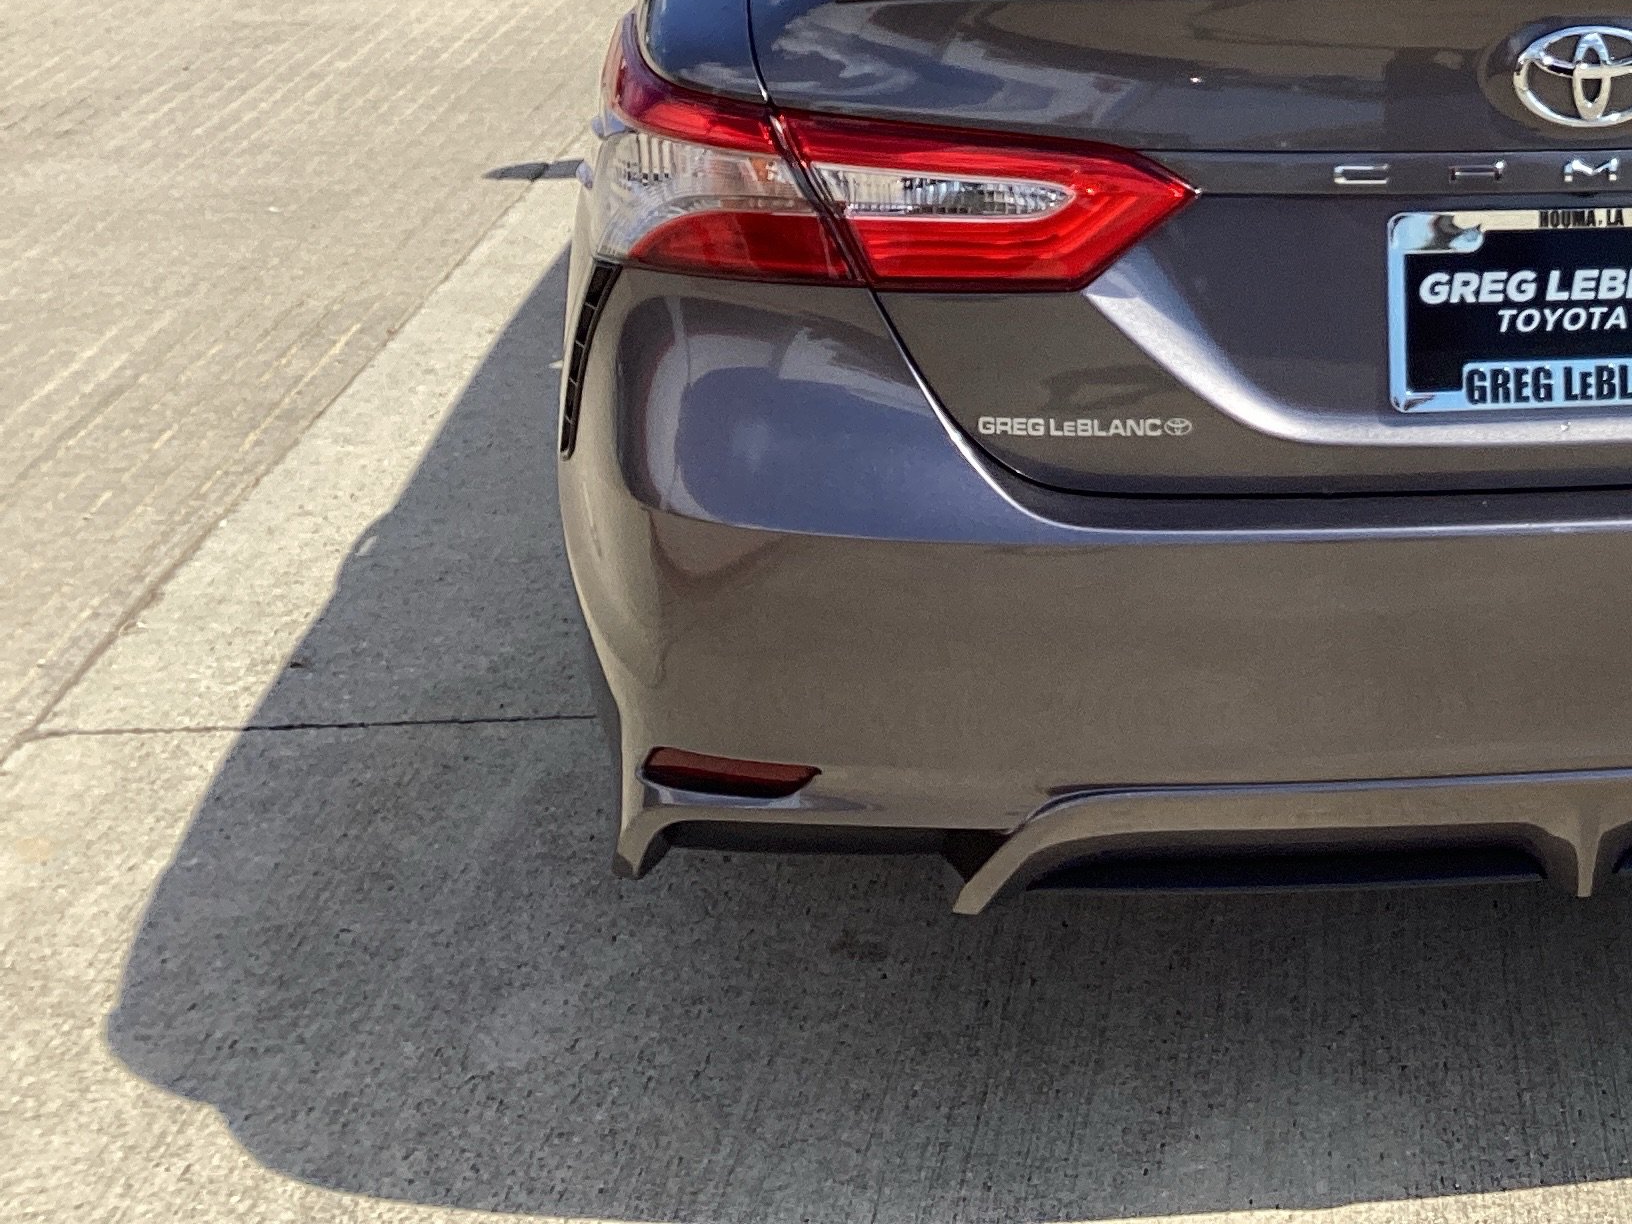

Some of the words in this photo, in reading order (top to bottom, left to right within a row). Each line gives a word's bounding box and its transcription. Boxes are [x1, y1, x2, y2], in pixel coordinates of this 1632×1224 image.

[1606, 208, 1624, 226] LA
[1419, 270, 1537, 304] GREG
[1498, 306, 1627, 332] TOYOTA
[1465, 367, 1553, 404] GREG
[978, 416, 1045, 435] GREG
